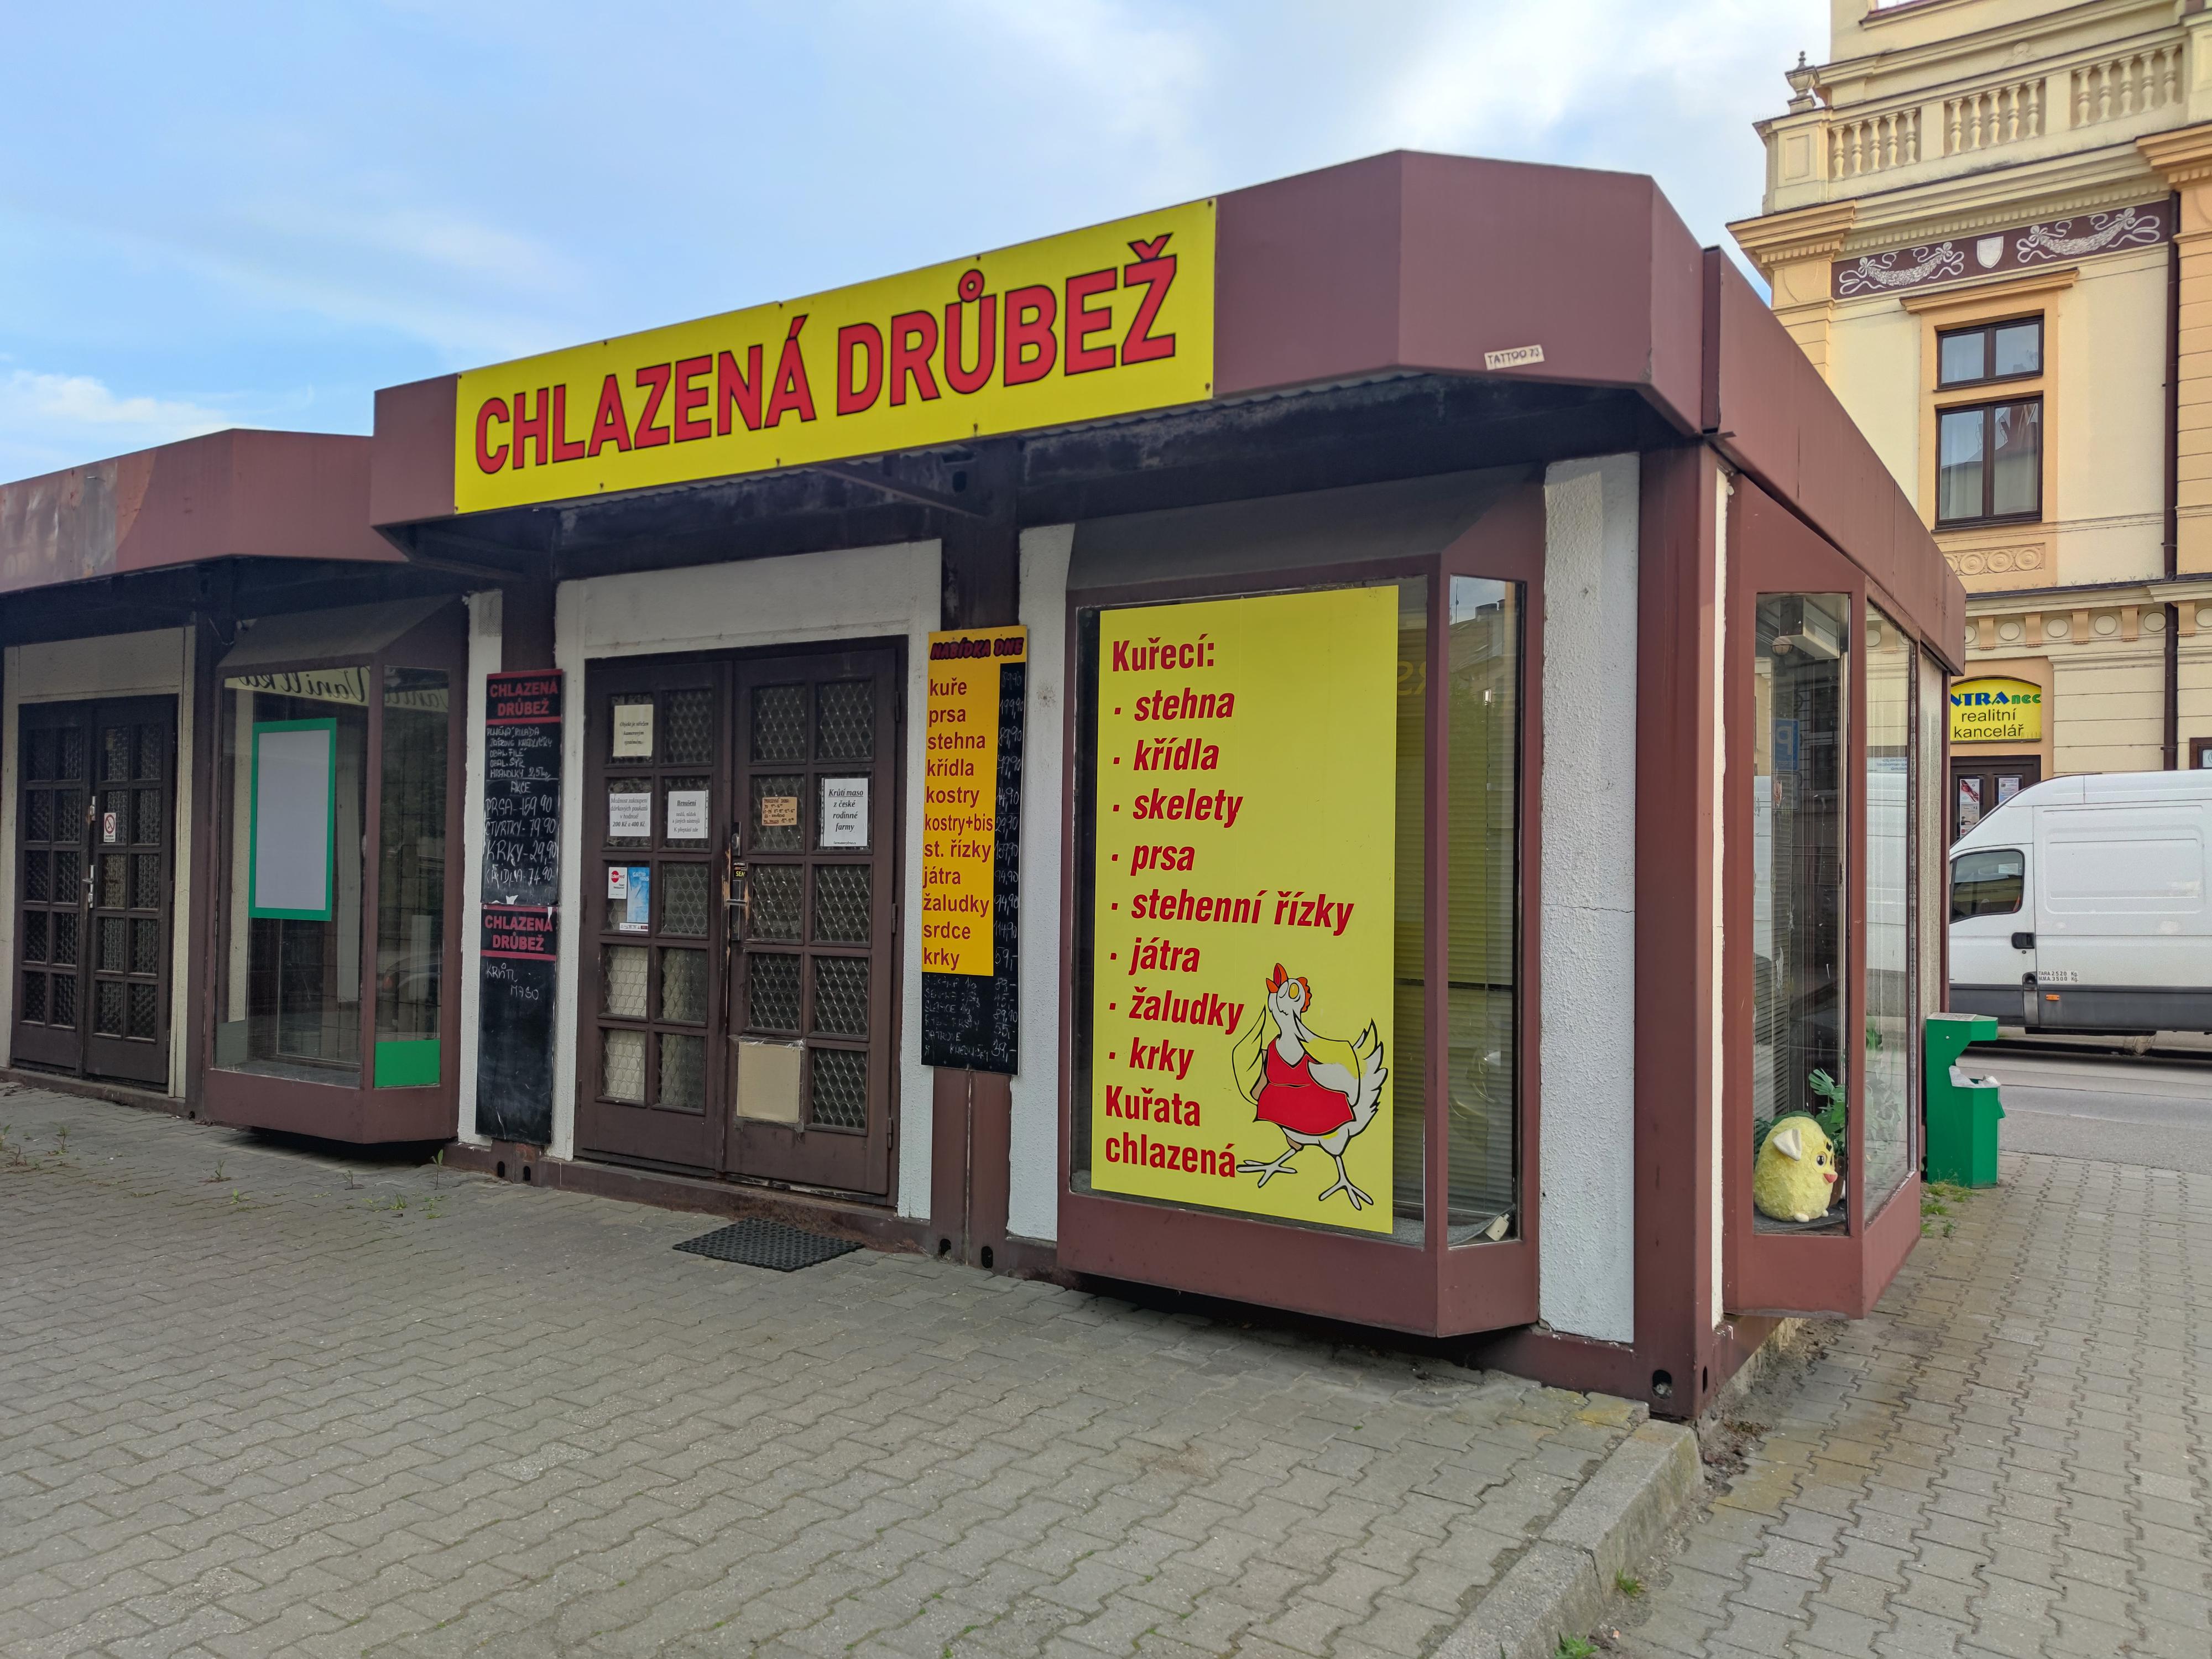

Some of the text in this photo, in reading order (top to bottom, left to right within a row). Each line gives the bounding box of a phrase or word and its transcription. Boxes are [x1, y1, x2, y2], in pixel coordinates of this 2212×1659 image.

[476, 232, 1178, 473] CHLAZENÁ DRŮBEŽ
[1488, 349, 1527, 364] TATTOO
[930, 637, 1024, 660] NABÍDKA DNE
[1113, 634, 1214, 672] Kuřecí:
[930, 677, 967, 696] kuře
[498, 698, 549, 716] DRŮBEŽ
[1134, 687, 1234, 721] stehna
[1962, 708, 2017, 722] realitní
[928, 708, 966, 727] prsa
[927, 732, 985, 749] stehna
[1954, 724, 2024, 738] kancelář
[1134, 737, 1219, 770] křídla
[927, 758, 974, 776] křídla
[828, 789, 846, 797] Krůtí
[926, 786, 979, 808] kostry
[1133, 788, 1243, 828] skelety
[836, 823, 854, 832] farmy
[925, 813, 993, 836] kostry+bis
[924, 839, 992, 863] st. řízky
[1130, 844, 1195, 876] prsa
[923, 867, 961, 888] játra
[923, 894, 989, 917] žaludky
[1131, 889, 1354, 936] stehenní řízky
[493, 931, 544, 951] DRŮBEŽ
[924, 922, 971, 940] srdce
[924, 947, 960, 971] krky
[1129, 937, 1200, 975] játra
[1129, 987, 1244, 1035] žaludky
[1129, 1037, 1194, 1079] krky
[1106, 1085, 1200, 1126] Kuřata
[1106, 1132, 1235, 1177] chlazená
